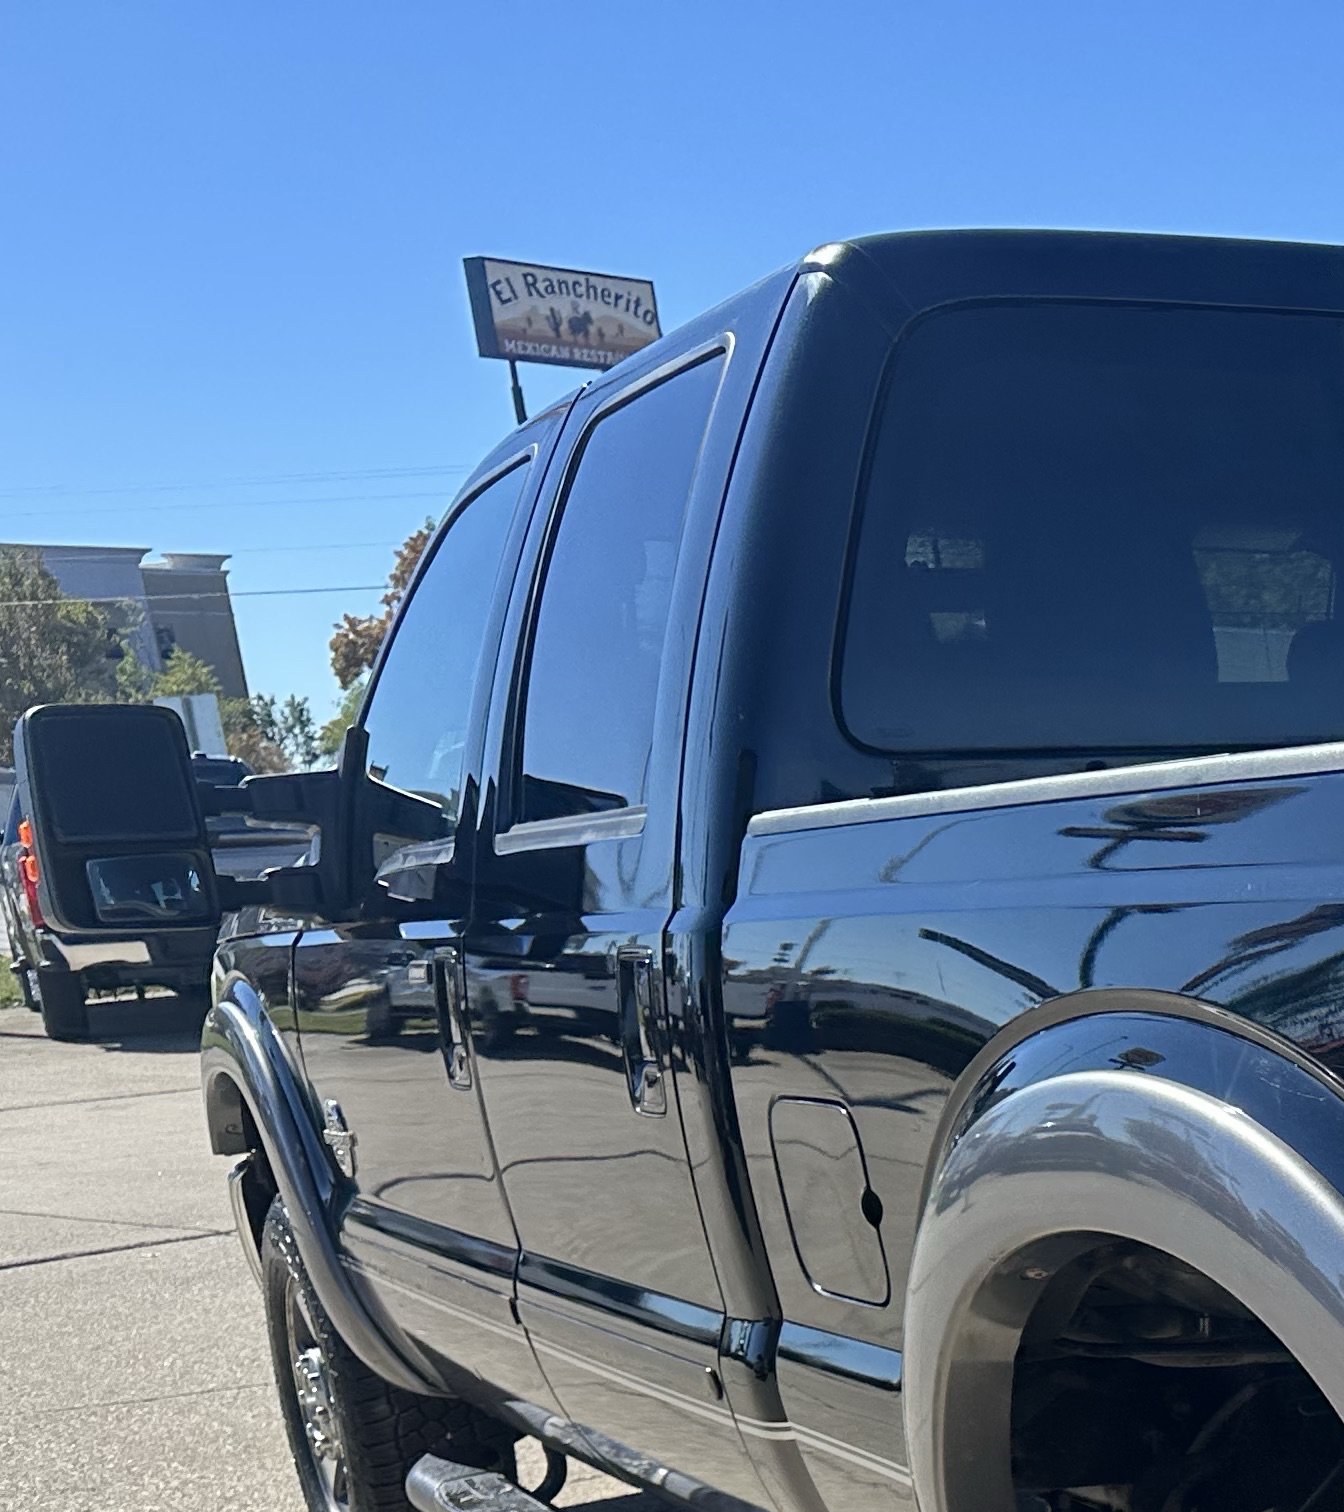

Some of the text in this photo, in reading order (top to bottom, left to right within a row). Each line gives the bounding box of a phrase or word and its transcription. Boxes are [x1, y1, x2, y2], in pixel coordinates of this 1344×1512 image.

[490, 272, 656, 325] El Rancherito
[503, 339, 571, 359] MEXICAN
